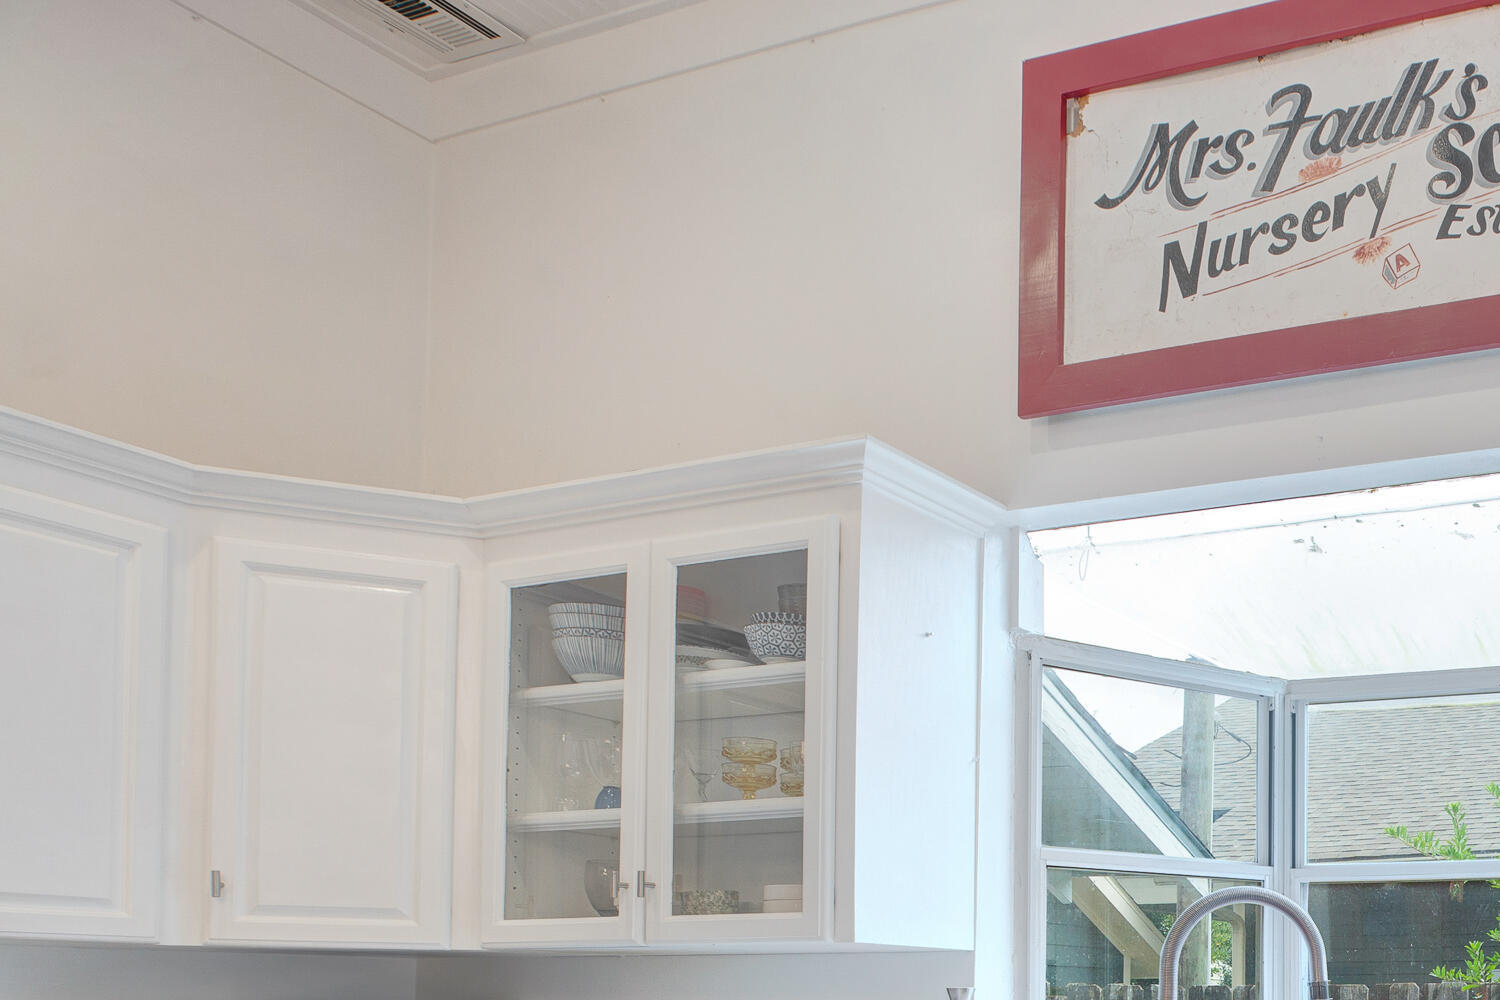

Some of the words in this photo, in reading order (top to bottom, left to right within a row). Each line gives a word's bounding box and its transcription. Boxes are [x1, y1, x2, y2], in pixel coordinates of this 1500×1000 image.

[1094, 119, 1257, 213] Mrs.
[1252, 57, 1490, 198] Faulk's
[1158, 162, 1398, 313] Nursery
